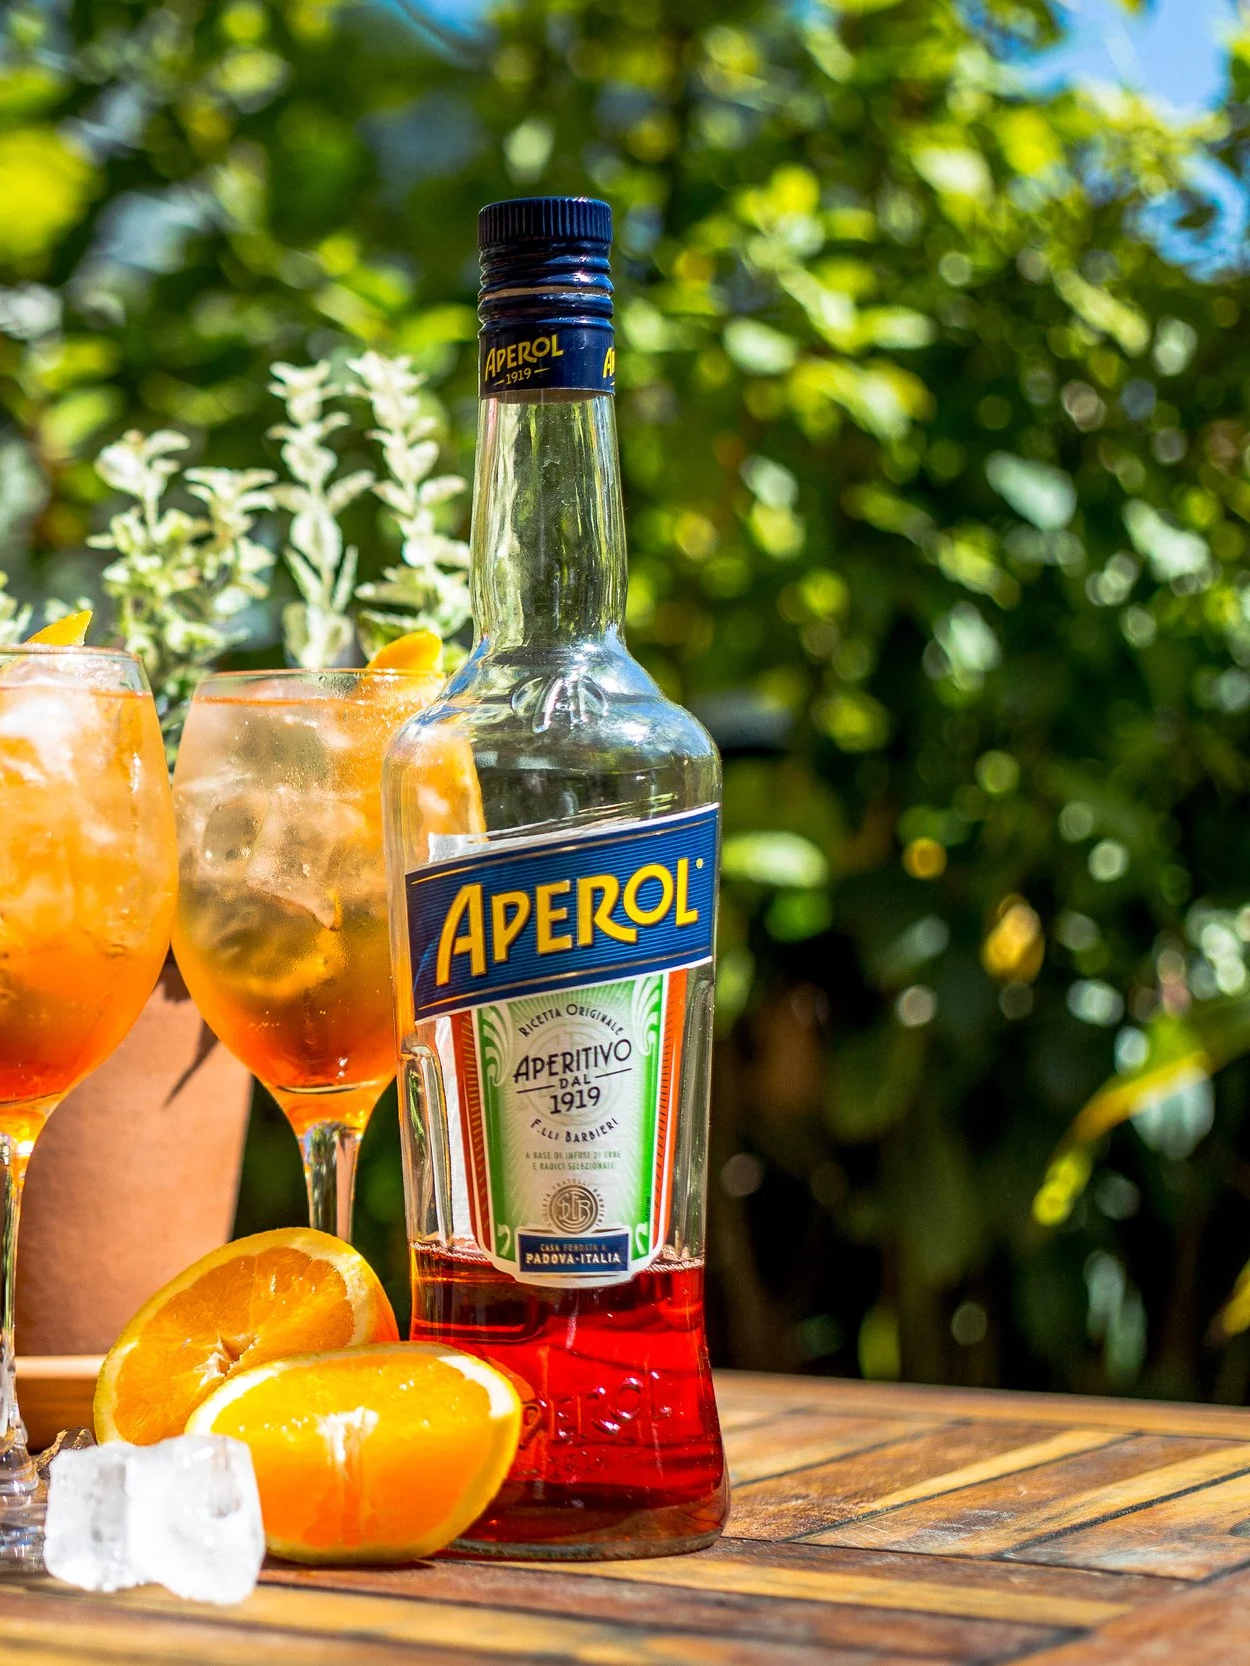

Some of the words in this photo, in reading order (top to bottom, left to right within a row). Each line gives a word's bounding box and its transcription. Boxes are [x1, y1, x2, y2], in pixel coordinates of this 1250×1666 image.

[484, 333, 564, 382] APEROL
[505, 367, 532, 385] 1919
[435, 856, 700, 987] APEROL
[518, 1008, 562, 1037] RICETTA
[512, 1039, 632, 1084] APERITIVO
[558, 1074, 591, 1089] DAL
[549, 1086, 601, 1115] 1919
[565, 1118, 618, 1143] BARBIERI
[532, 1151, 551, 1160] BASE
[539, 1243, 560, 1252] CASA
